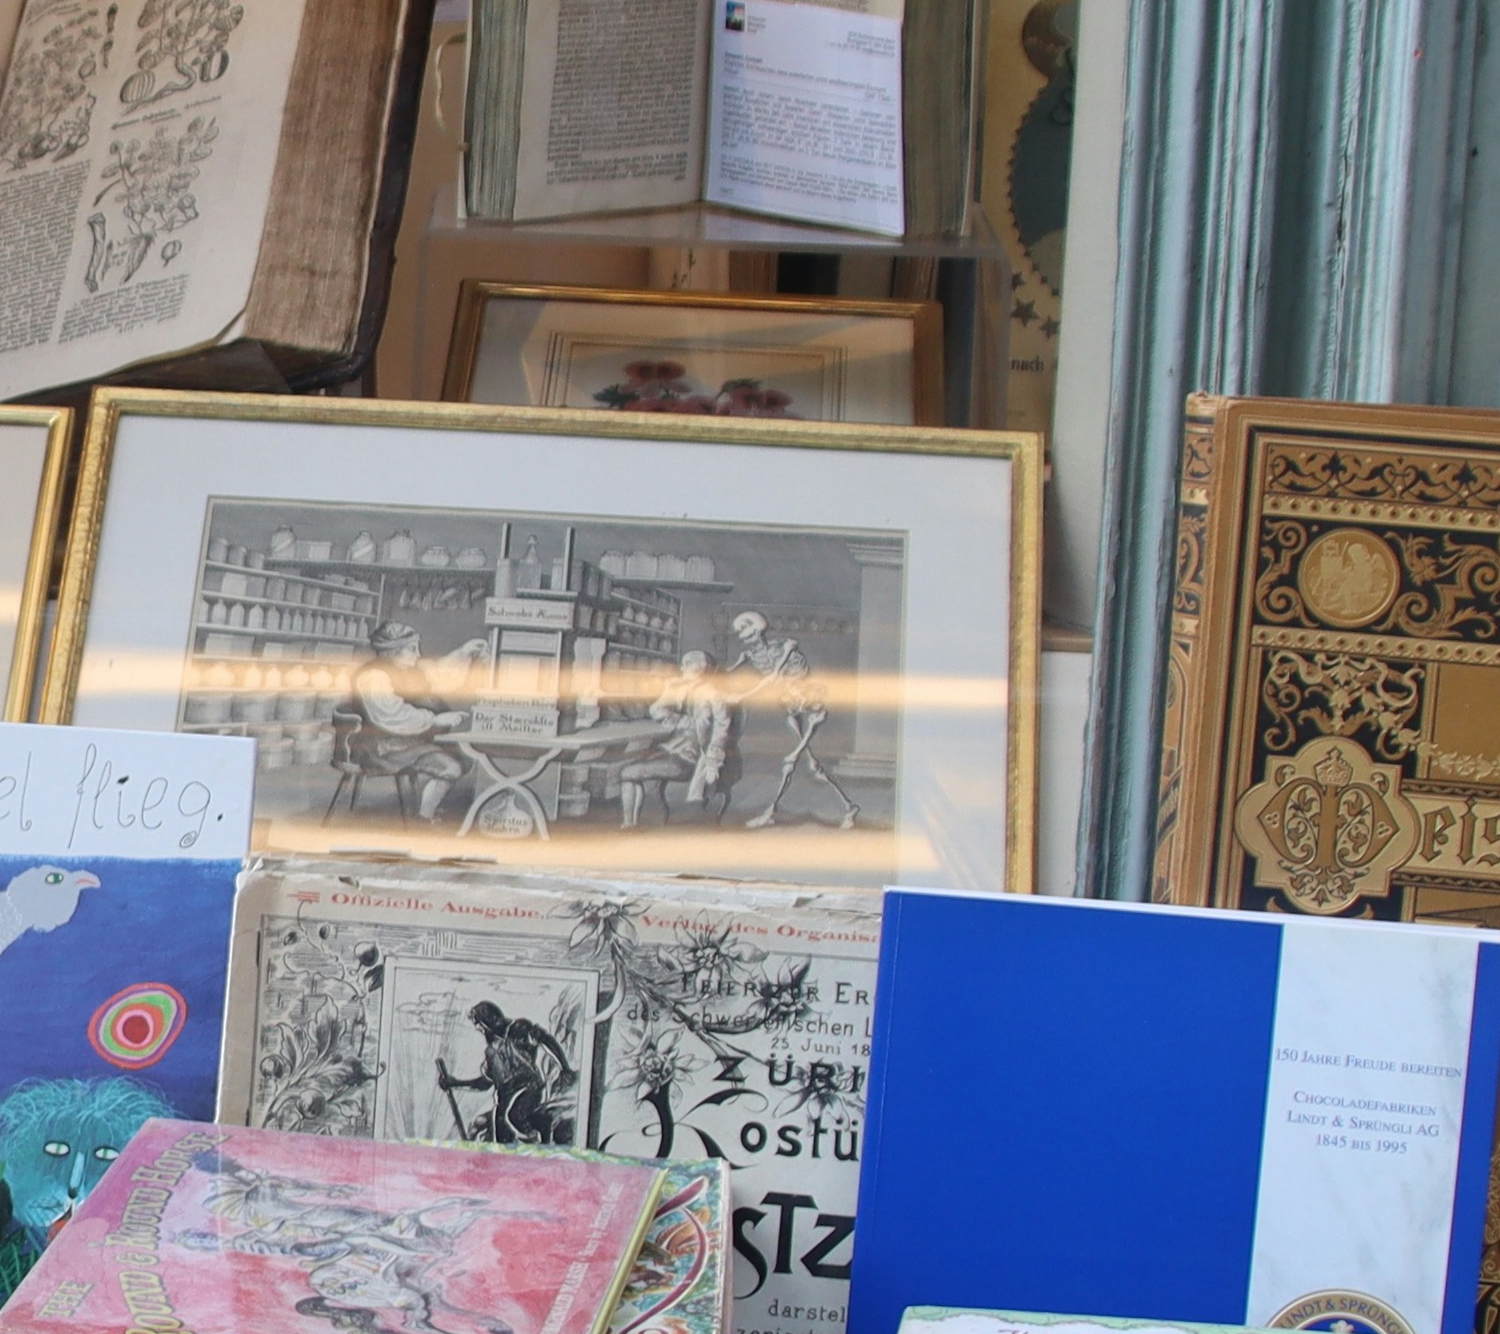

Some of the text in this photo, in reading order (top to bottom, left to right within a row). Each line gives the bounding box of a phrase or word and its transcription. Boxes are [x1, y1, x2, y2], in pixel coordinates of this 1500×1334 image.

[330, 892, 434, 914] Offizielle
[640, 915, 718, 934] Verlag
[729, 921, 768, 935] des
[835, 982, 870, 1005] ER
[801, 1040, 842, 1055] Juni
[852, 1043, 871, 1057] 18
[1275, 1047, 1298, 1061] 150
[1286, 1110, 1440, 1137] LINDT & SPRÜNGLI AG
[1316, 1134, 1347, 1149] 1845
[1376, 1140, 1408, 1155] 1995
[131, 1131, 232, 1187] HORSE
[37, 1281, 95, 1317] THE
[1325, 1298, 1336, 1310] &
